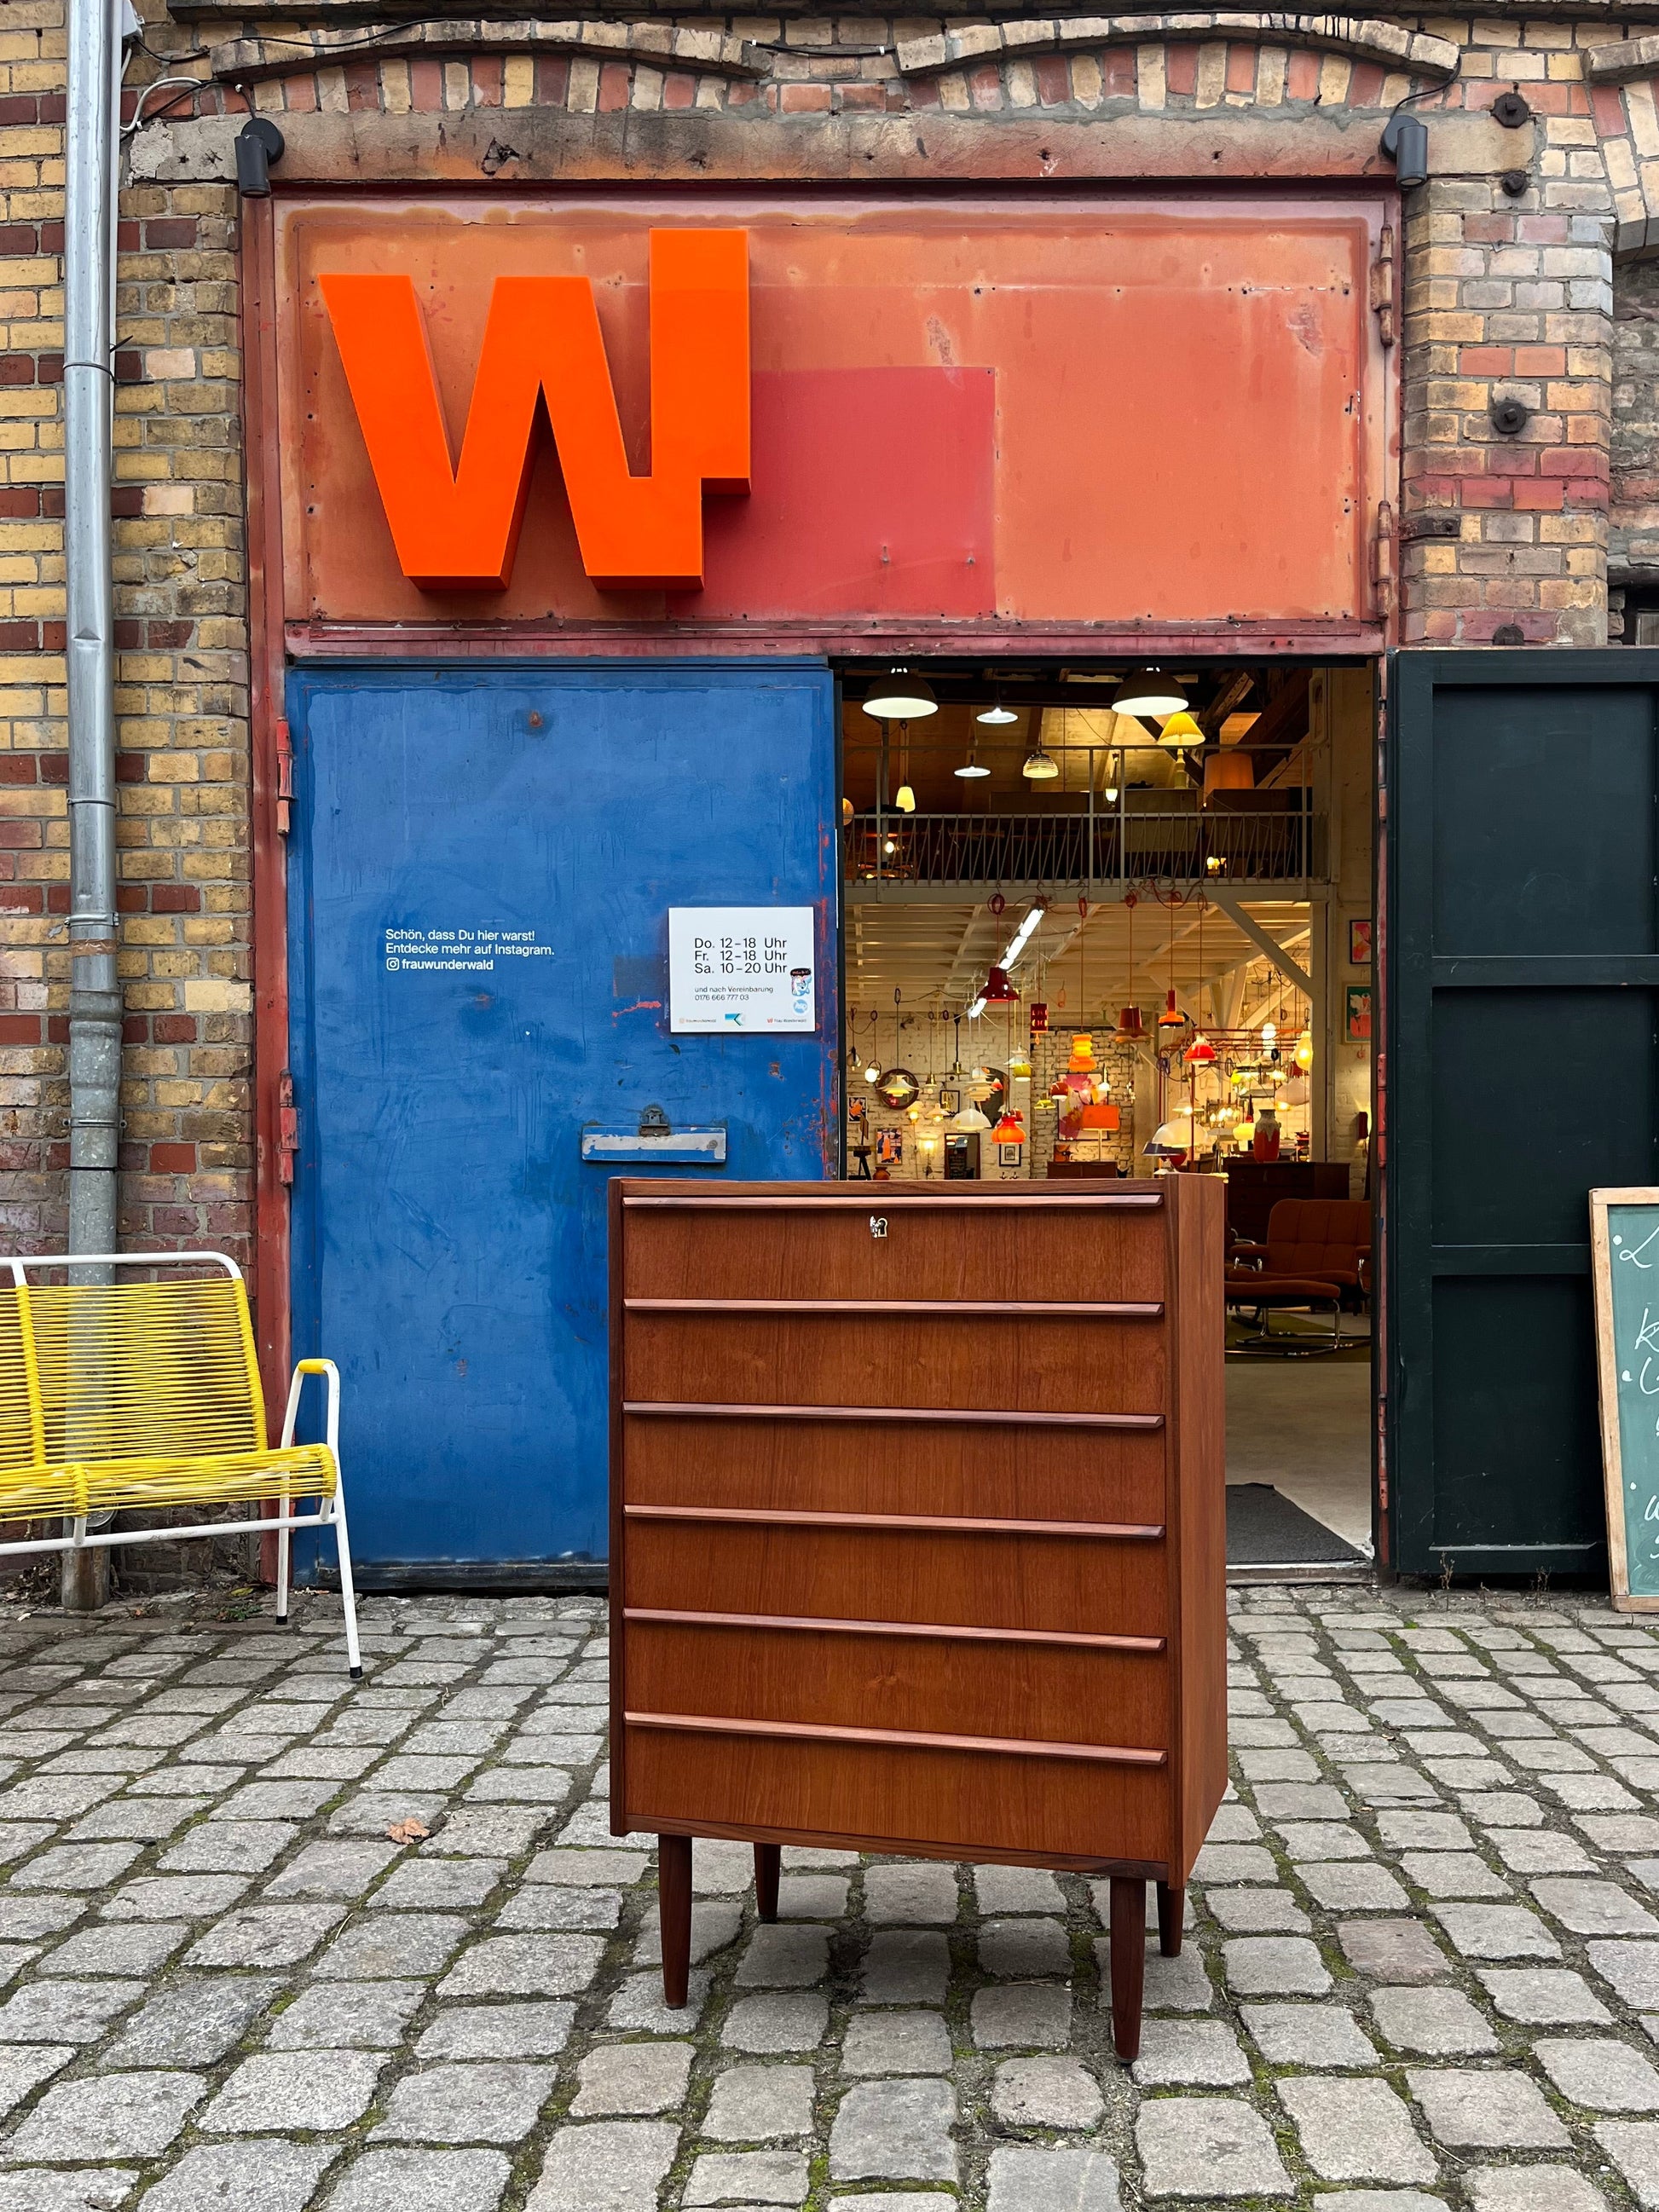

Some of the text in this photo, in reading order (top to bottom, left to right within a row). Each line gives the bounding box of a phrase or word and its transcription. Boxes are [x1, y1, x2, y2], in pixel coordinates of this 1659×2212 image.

[385, 928, 535, 942] Schön, dass Du hier warst!
[694, 937, 715, 949] Do.
[764, 937, 788, 949] Uhr
[385, 942, 555, 957] Entdecke mehr auf Instagram.
[694, 950, 709, 962] Fr.
[764, 950, 788, 962] Uhr
[402, 958, 494, 970] frauwunderwald
[694, 962, 714, 974] Sa.
[764, 962, 788, 973] Uhr
